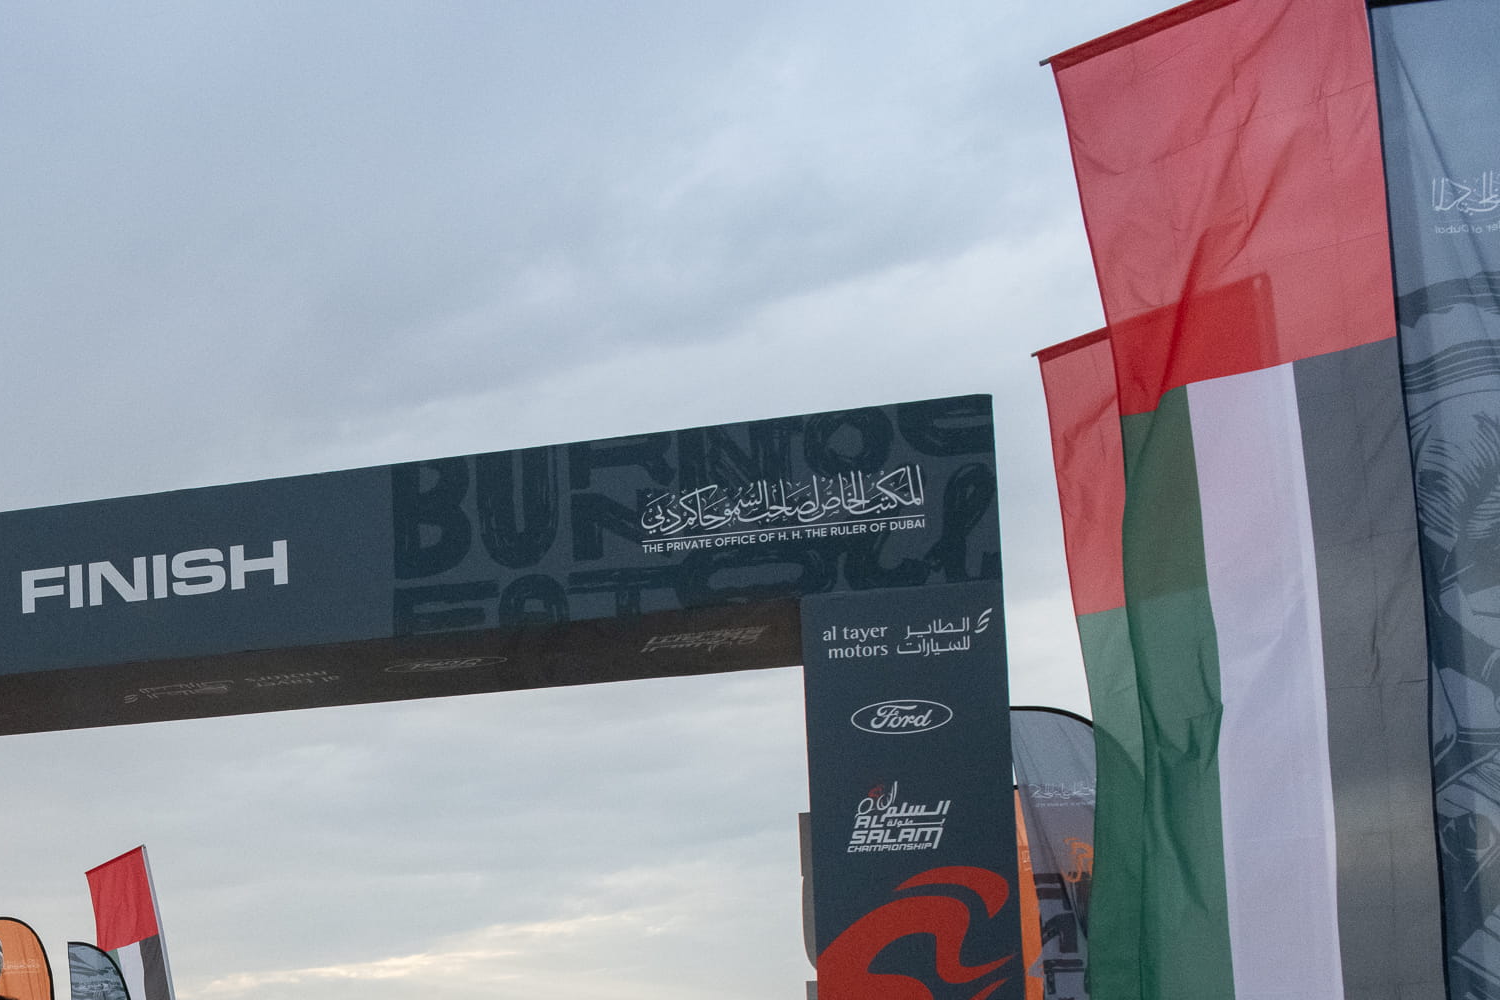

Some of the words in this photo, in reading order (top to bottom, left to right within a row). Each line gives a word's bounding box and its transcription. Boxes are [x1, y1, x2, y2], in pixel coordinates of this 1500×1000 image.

[642, 543, 664, 554] THE
[666, 539, 712, 551] PRIVATE
[714, 534, 757, 548] OFFICE
[759, 532, 775, 543] OF
[778, 530, 789, 541] H.
[792, 529, 803, 540] H.
[805, 526, 827, 538] THE
[830, 523, 867, 536] RULER
[869, 521, 886, 532] OF
[890, 518, 925, 530] DUBAI
[21, 539, 288, 614] FINISH
[823, 626, 836, 641] al
[843, 626, 888, 643] tayer
[828, 644, 888, 659] motors
[870, 705, 932, 728] Ford
[854, 815, 884, 829] AL
[847, 842, 932, 853] CHAMPIONSHIP
[849, 827, 943, 849] SALAM
